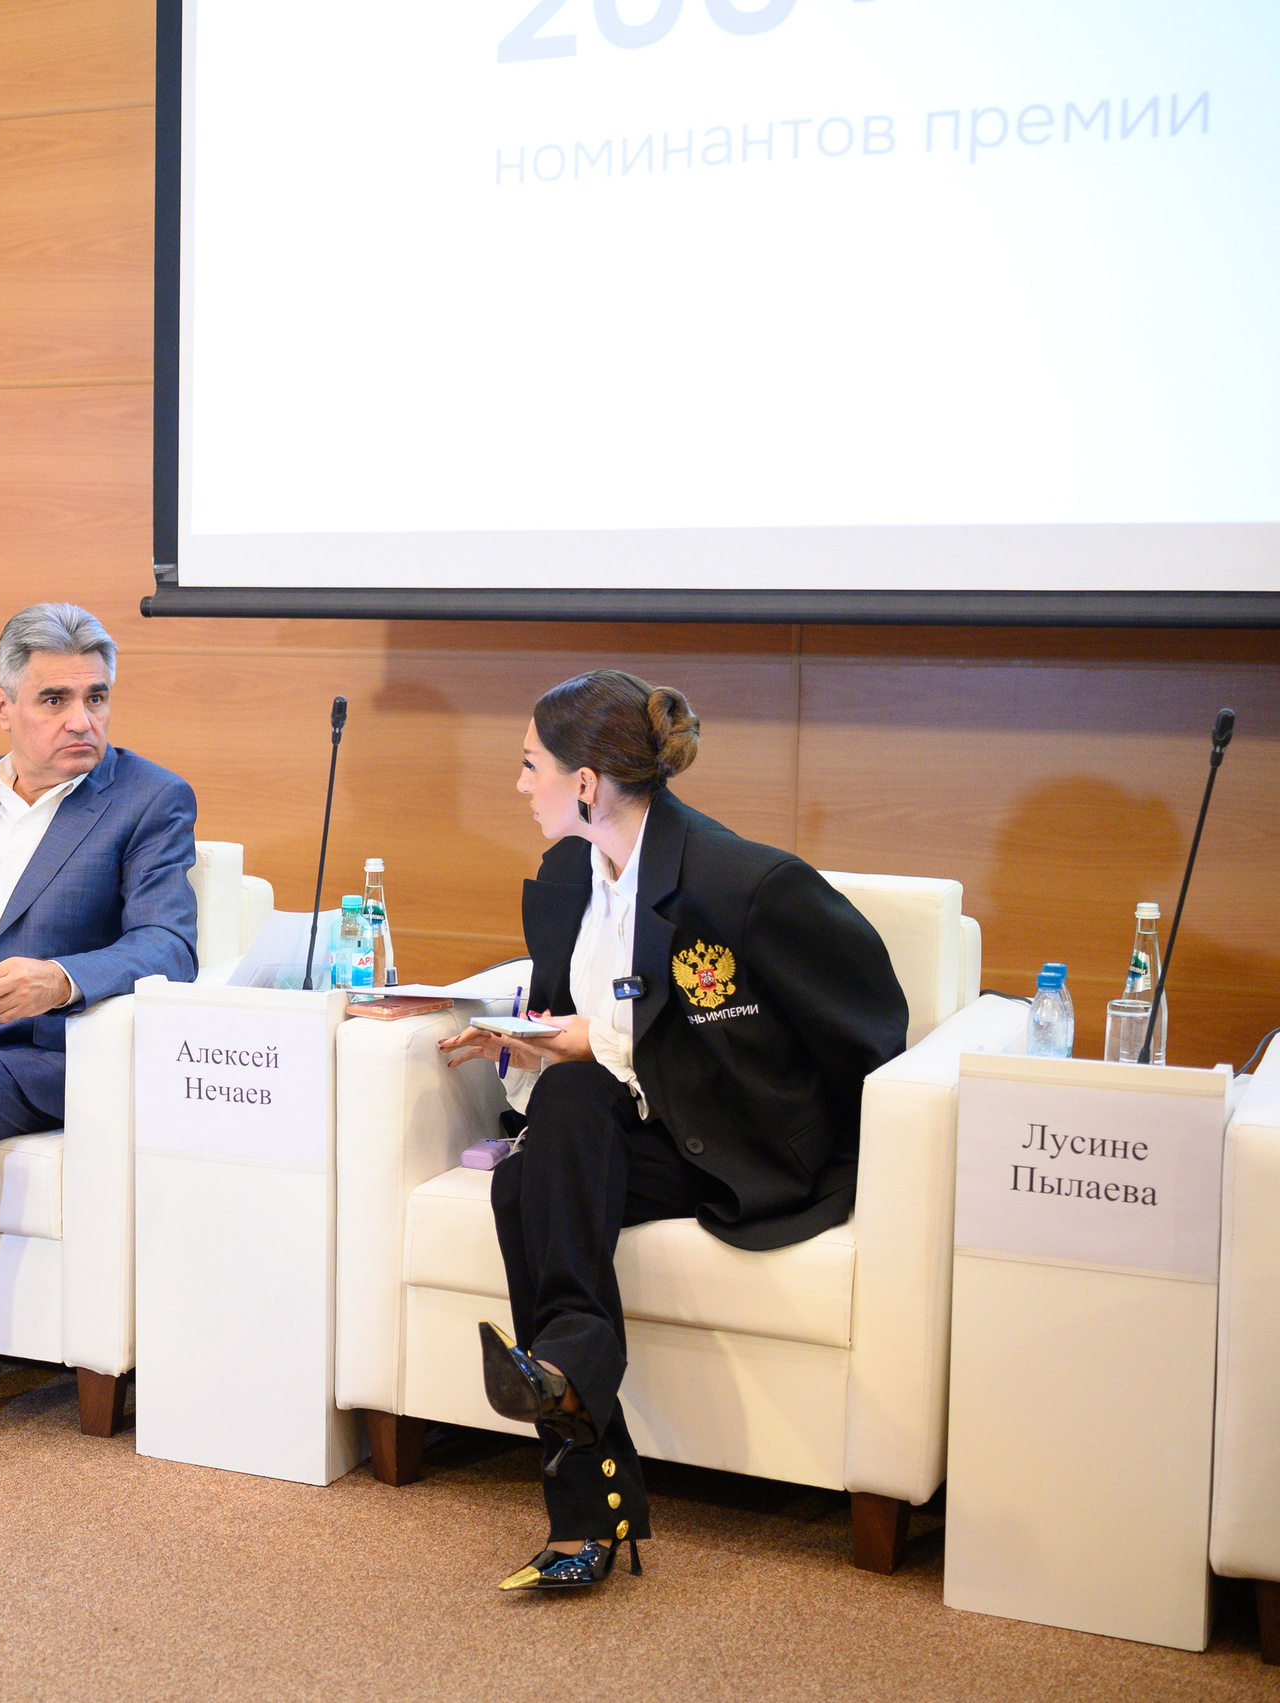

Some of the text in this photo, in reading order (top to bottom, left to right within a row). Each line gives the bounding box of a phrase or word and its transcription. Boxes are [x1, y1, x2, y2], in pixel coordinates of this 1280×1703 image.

[493, 90, 1212, 186] номинантов премии
[705, 1004, 759, 1022] ИМПЕРИИ
[176, 1039, 279, 1069] Алексей
[184, 1076, 272, 1105] Нечаев
[1021, 1123, 1150, 1161] Лусине
[1009, 1164, 1158, 1207] Пылаева
